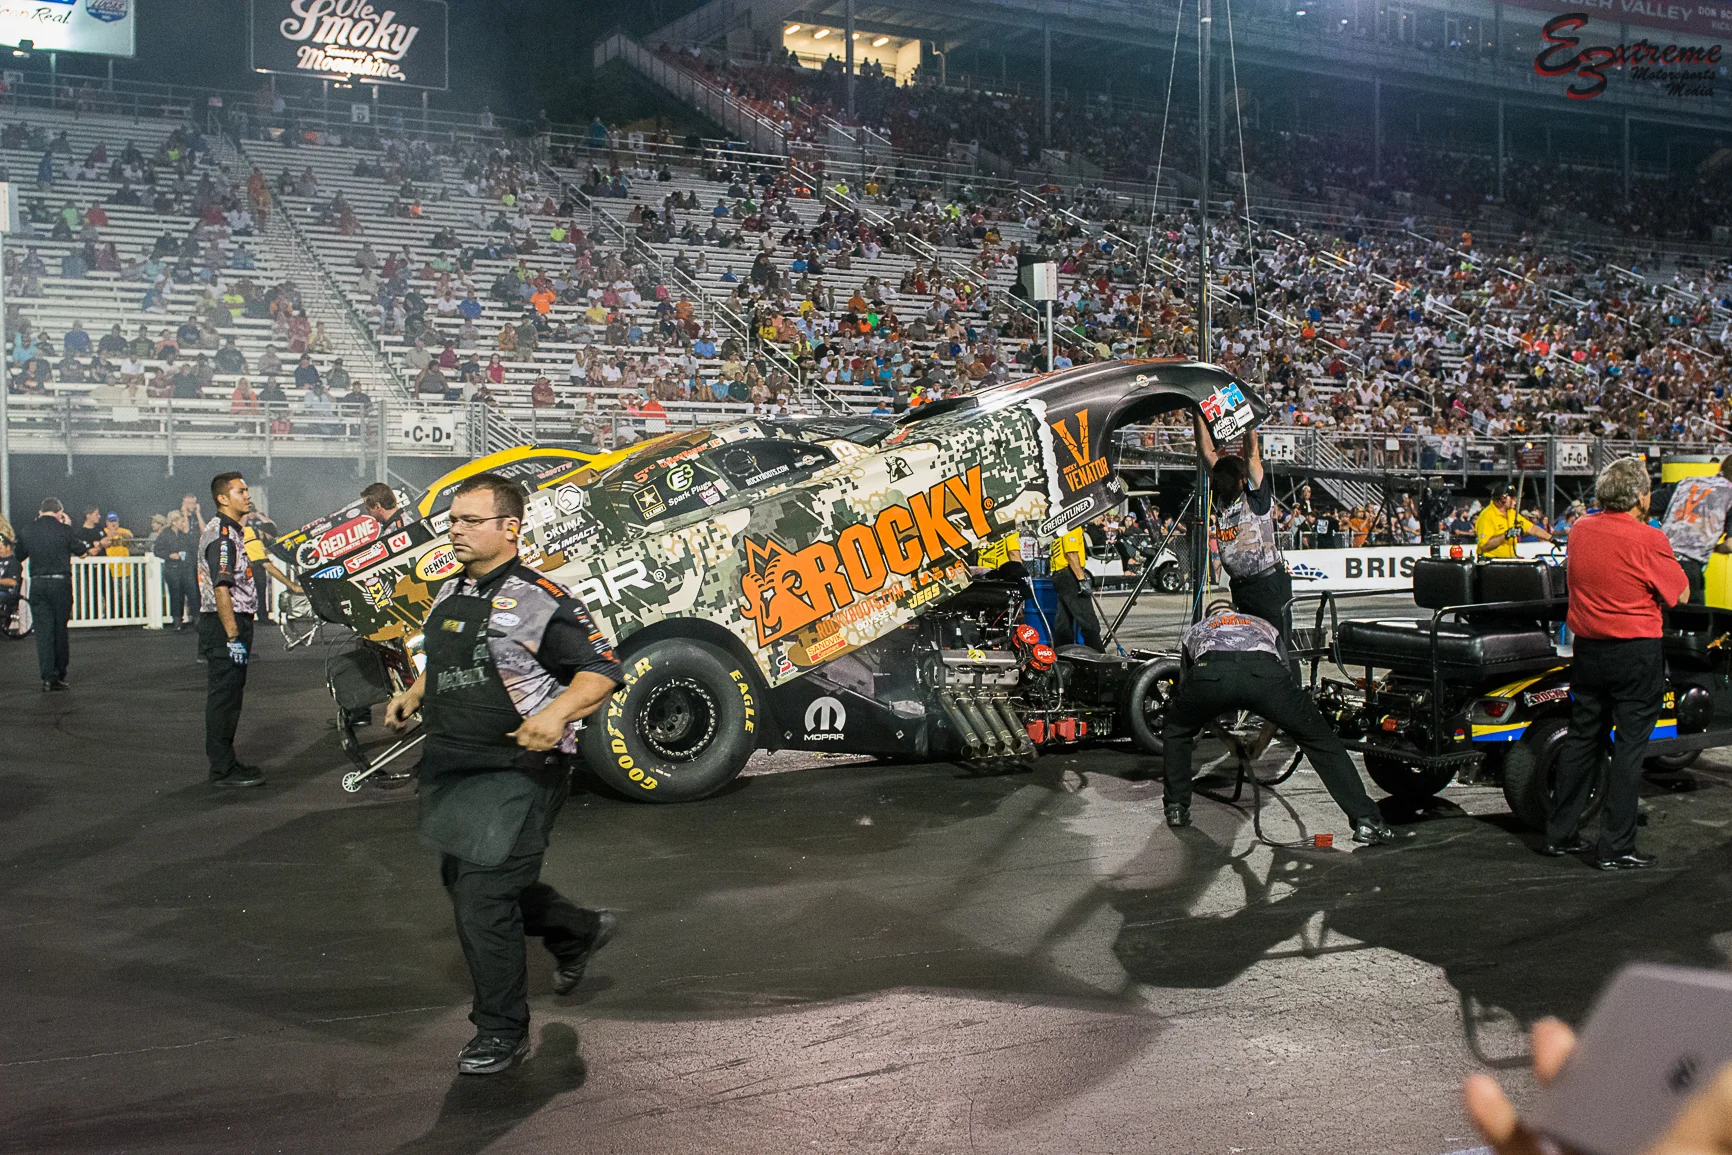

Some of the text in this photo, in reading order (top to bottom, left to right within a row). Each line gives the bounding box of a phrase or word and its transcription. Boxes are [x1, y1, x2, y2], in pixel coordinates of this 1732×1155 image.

[335, 0, 380, 24] Ole
[1620, 0, 1693, 22] VALLEY
[279, 0, 420, 61] Smoky
[745, 464, 790, 487] ROCKYBOOTS.COM
[1062, 463, 1077, 474] ROCKY
[1065, 456, 1110, 492] VENATOR
[668, 490, 691, 506] Spark
[690, 480, 713, 495] Plugs
[544, 516, 586, 540] OKUMA
[1043, 500, 1090, 534] FREIGHTLINER
[320, 532, 345, 556] RED
[345, 519, 375, 540] LINE
[392, 535, 407, 549] CV
[561, 525, 597, 549] IMPACT
[795, 464, 992, 617] ROCKY
[423, 549, 457, 577] PENNZOI
[1345, 556, 1415, 579] BRIS
[907, 583, 941, 610] JEGS
[815, 583, 906, 638] ROCKYBOOTS.COM
[856, 608, 894, 631] ODYSSEY
[807, 632, 842, 656] SANDVIK
[1022, 629, 1035, 640] MSD
[729, 669, 756, 734] EAGLE
[803, 733, 845, 741] MOPAR
